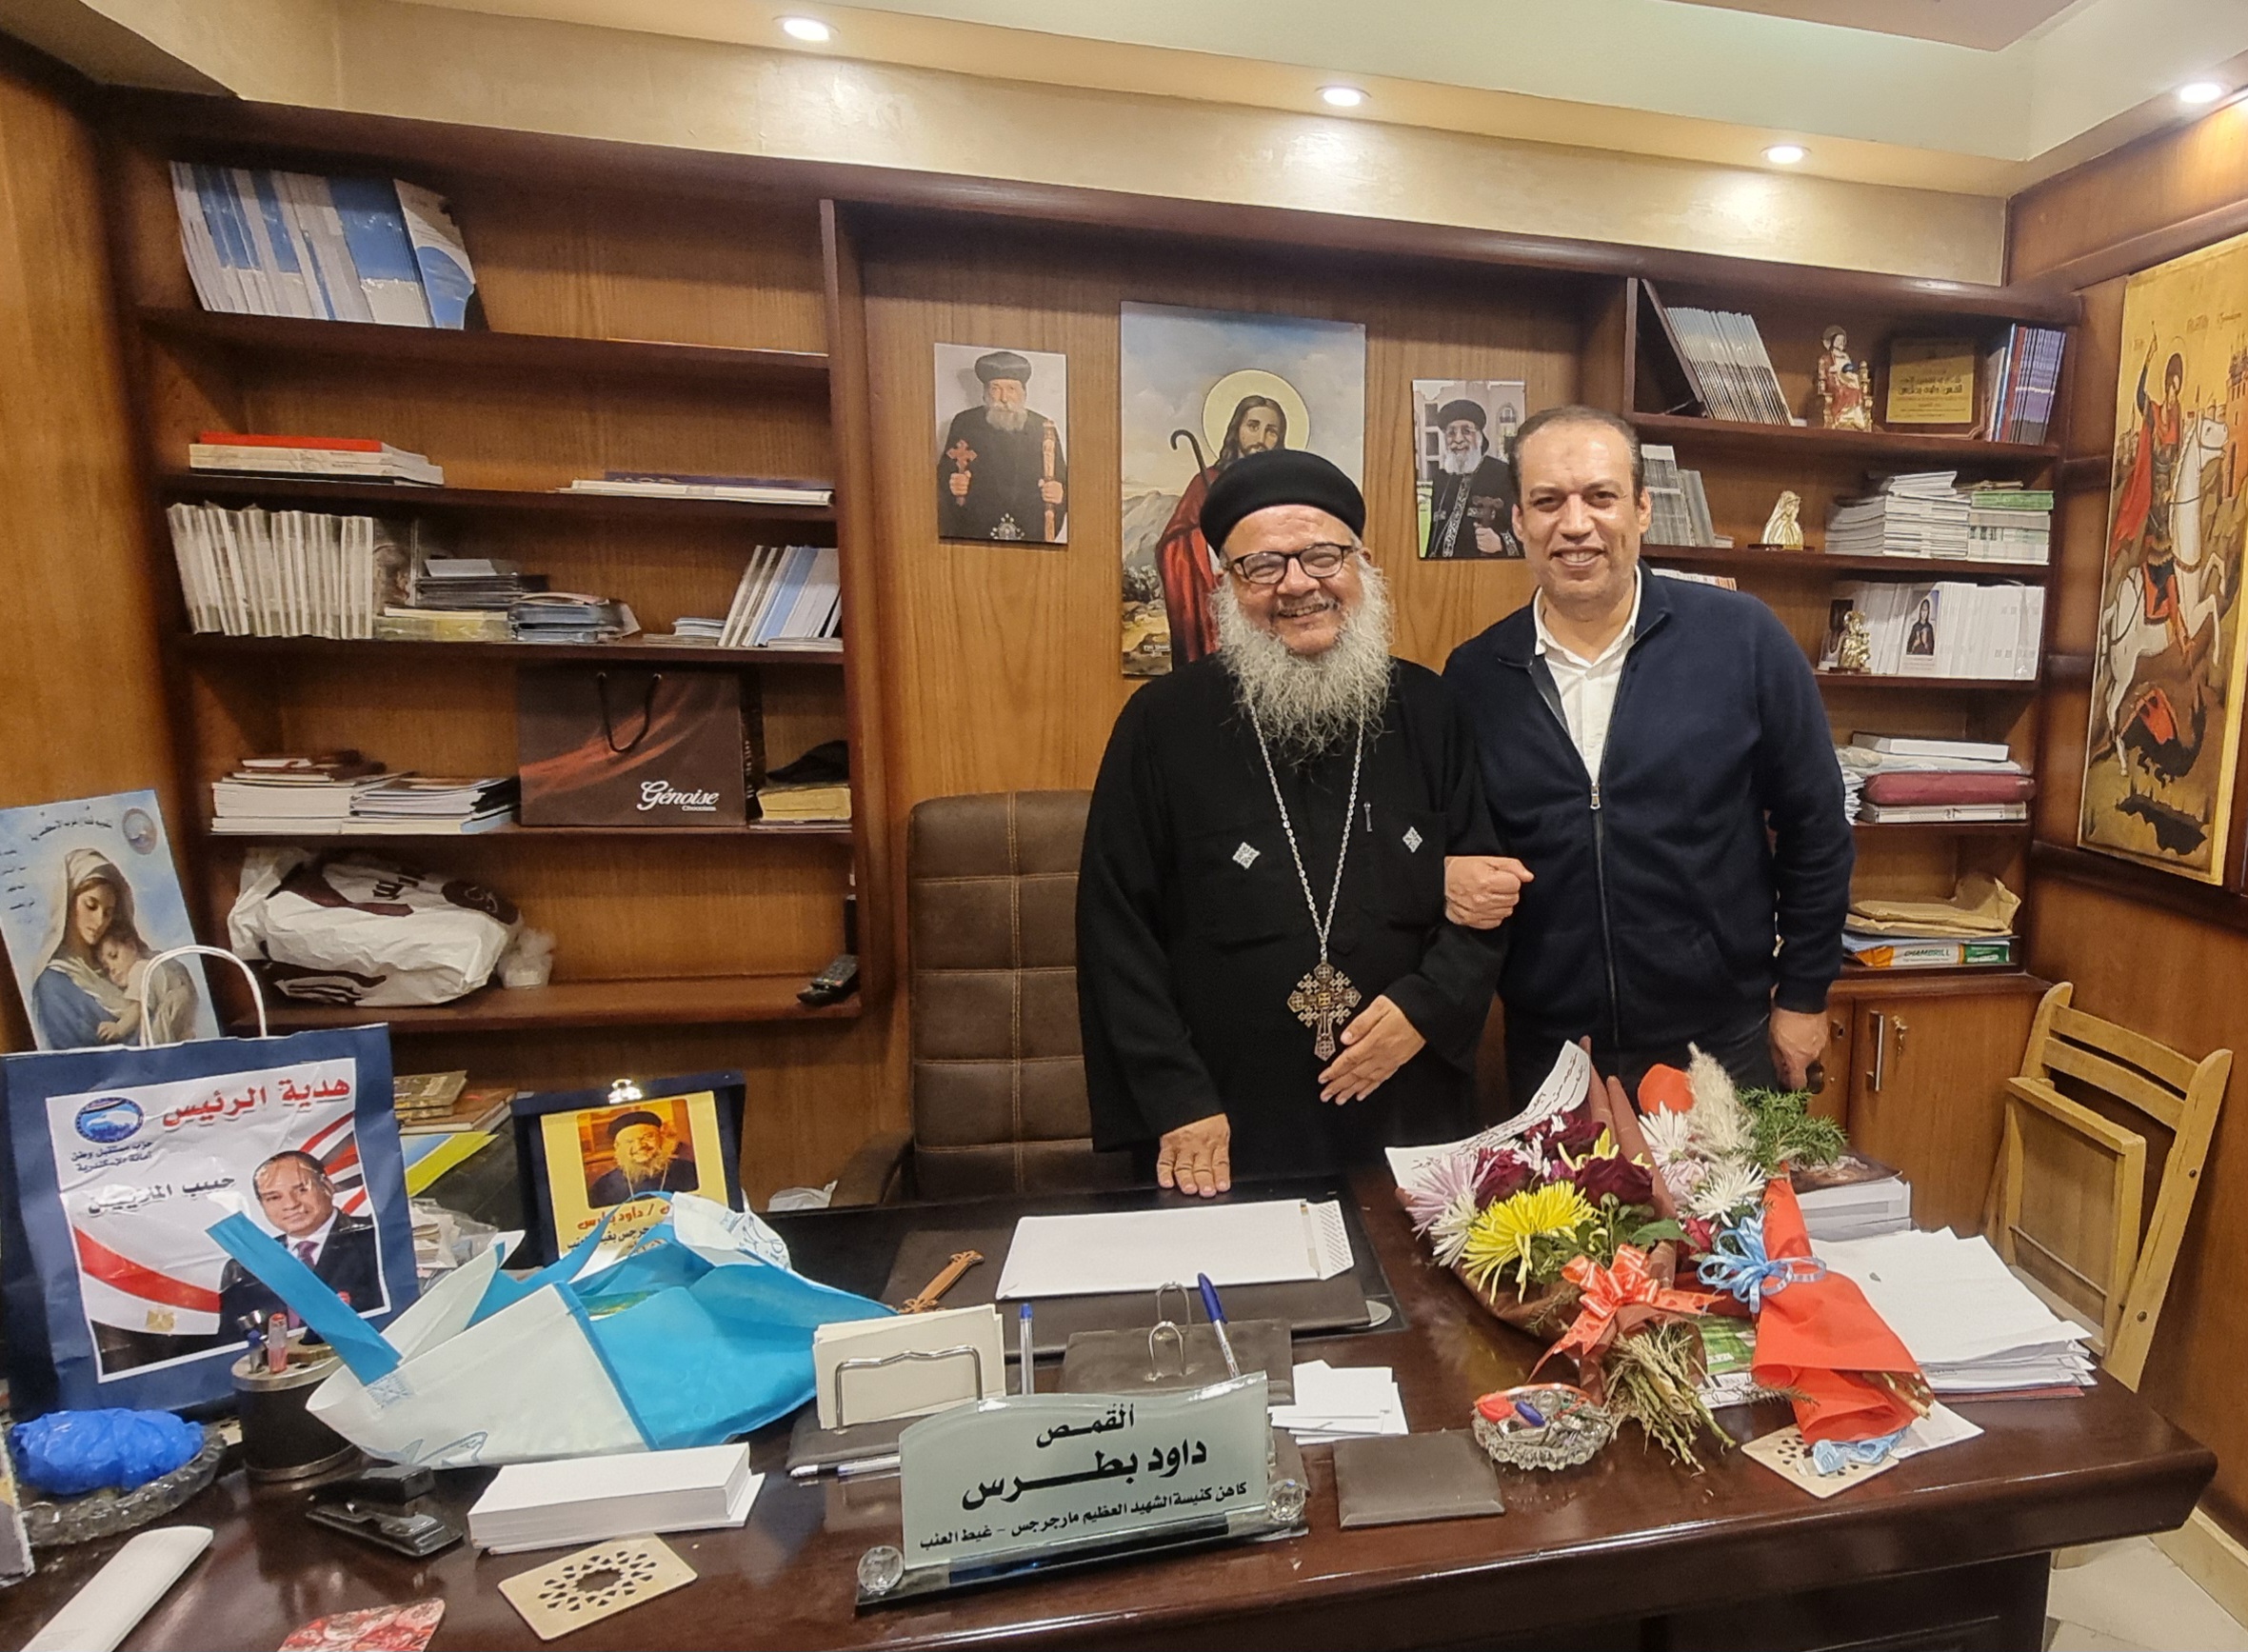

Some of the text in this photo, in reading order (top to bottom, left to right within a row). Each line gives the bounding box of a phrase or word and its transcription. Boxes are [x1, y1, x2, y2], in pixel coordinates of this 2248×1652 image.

[636, 781, 720, 810] Génoise
[163, 1079, 350, 1126] هدية الرئيس
[618, 1206, 644, 1223] داود
[1036, 1403, 1134, 1448] القمص
[962, 1439, 1206, 1511] داود بطرس
[1173, 1487, 1212, 1506] كنيسة
[1215, 1482, 1247, 1502] كاهن
[1083, 1503, 1127, 1525] العظيم
[1130, 1495, 1172, 1515] الشهيد
[962, 1524, 992, 1543] غيط
[1011, 1511, 1079, 1537] مارجرجس
[920, 1531, 959, 1551] العنب
